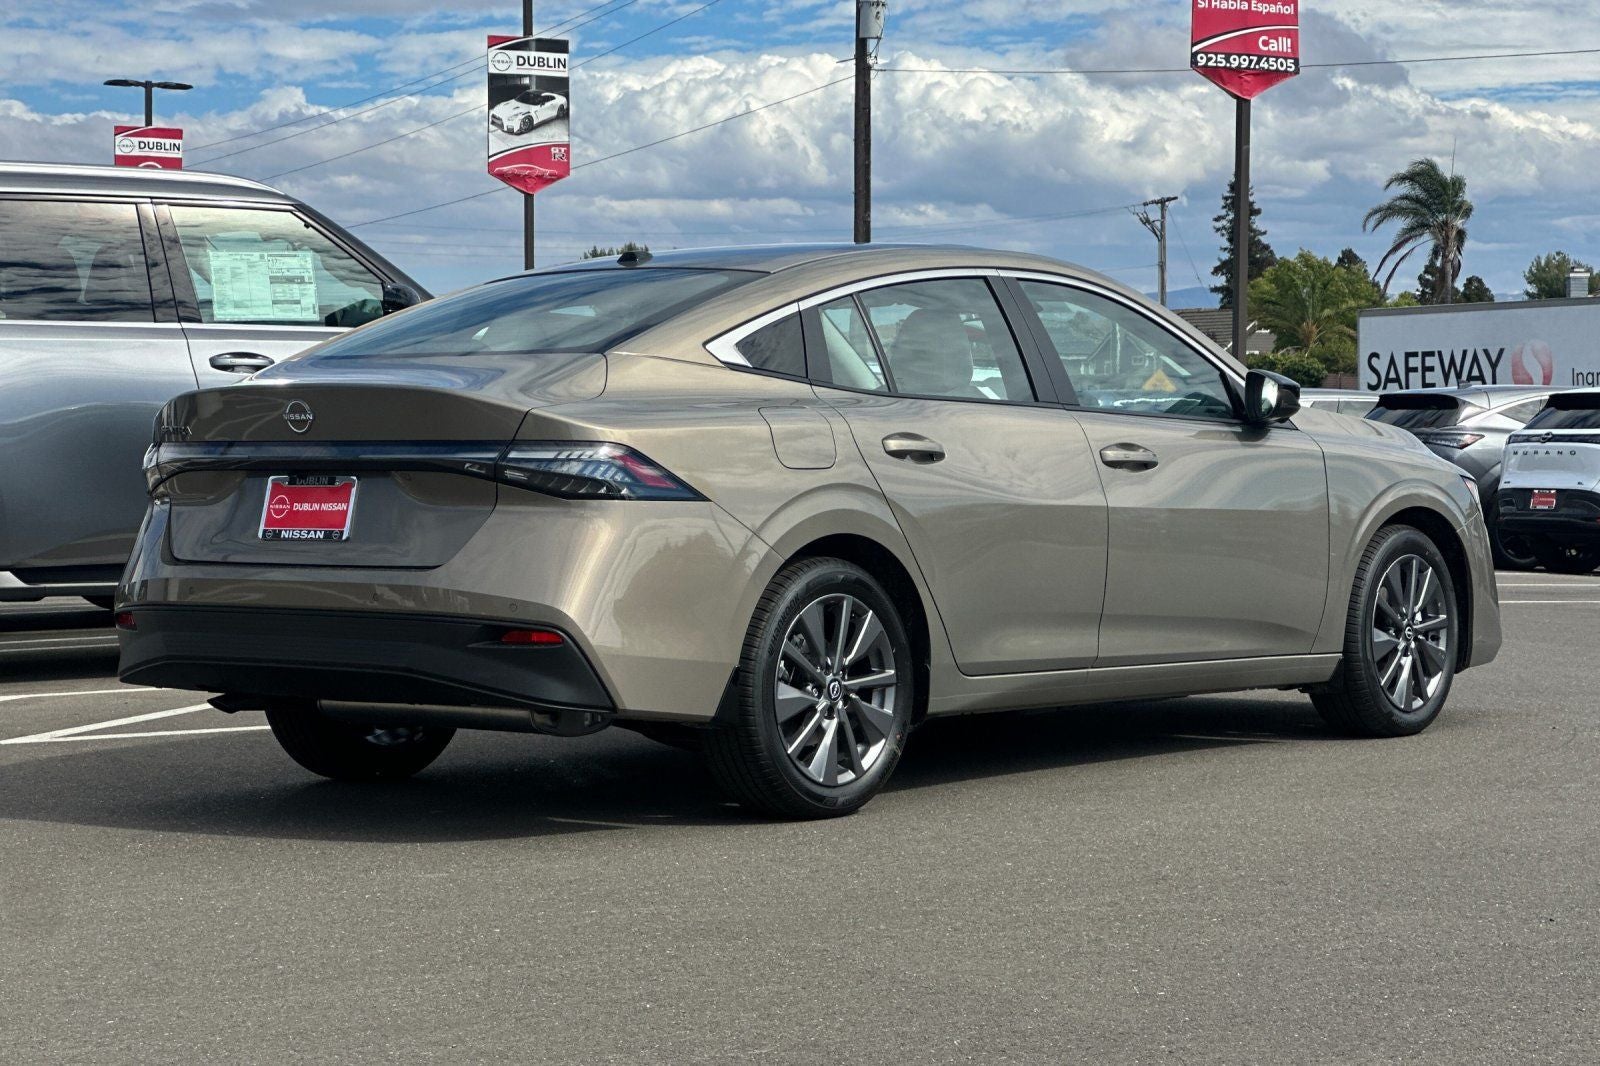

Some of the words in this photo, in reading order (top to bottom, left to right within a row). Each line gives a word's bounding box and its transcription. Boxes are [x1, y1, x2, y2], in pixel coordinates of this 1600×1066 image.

[1212, 0, 1248, 10] Habla
[1251, 1, 1294, 14] Español
[1258, 36, 1291, 52] Call!
[516, 55, 566, 69] DUBLIN
[1197, 54, 1295, 71] 925.997.4505
[138, 141, 181, 151] DUBLIN
[1367, 348, 1505, 391] SAFEWAY
[296, 475, 329, 485] DUBLIN
[293, 503, 319, 511] DUBLIN
[320, 503, 347, 511] NISSAN
[281, 530, 324, 539] NISSAN
